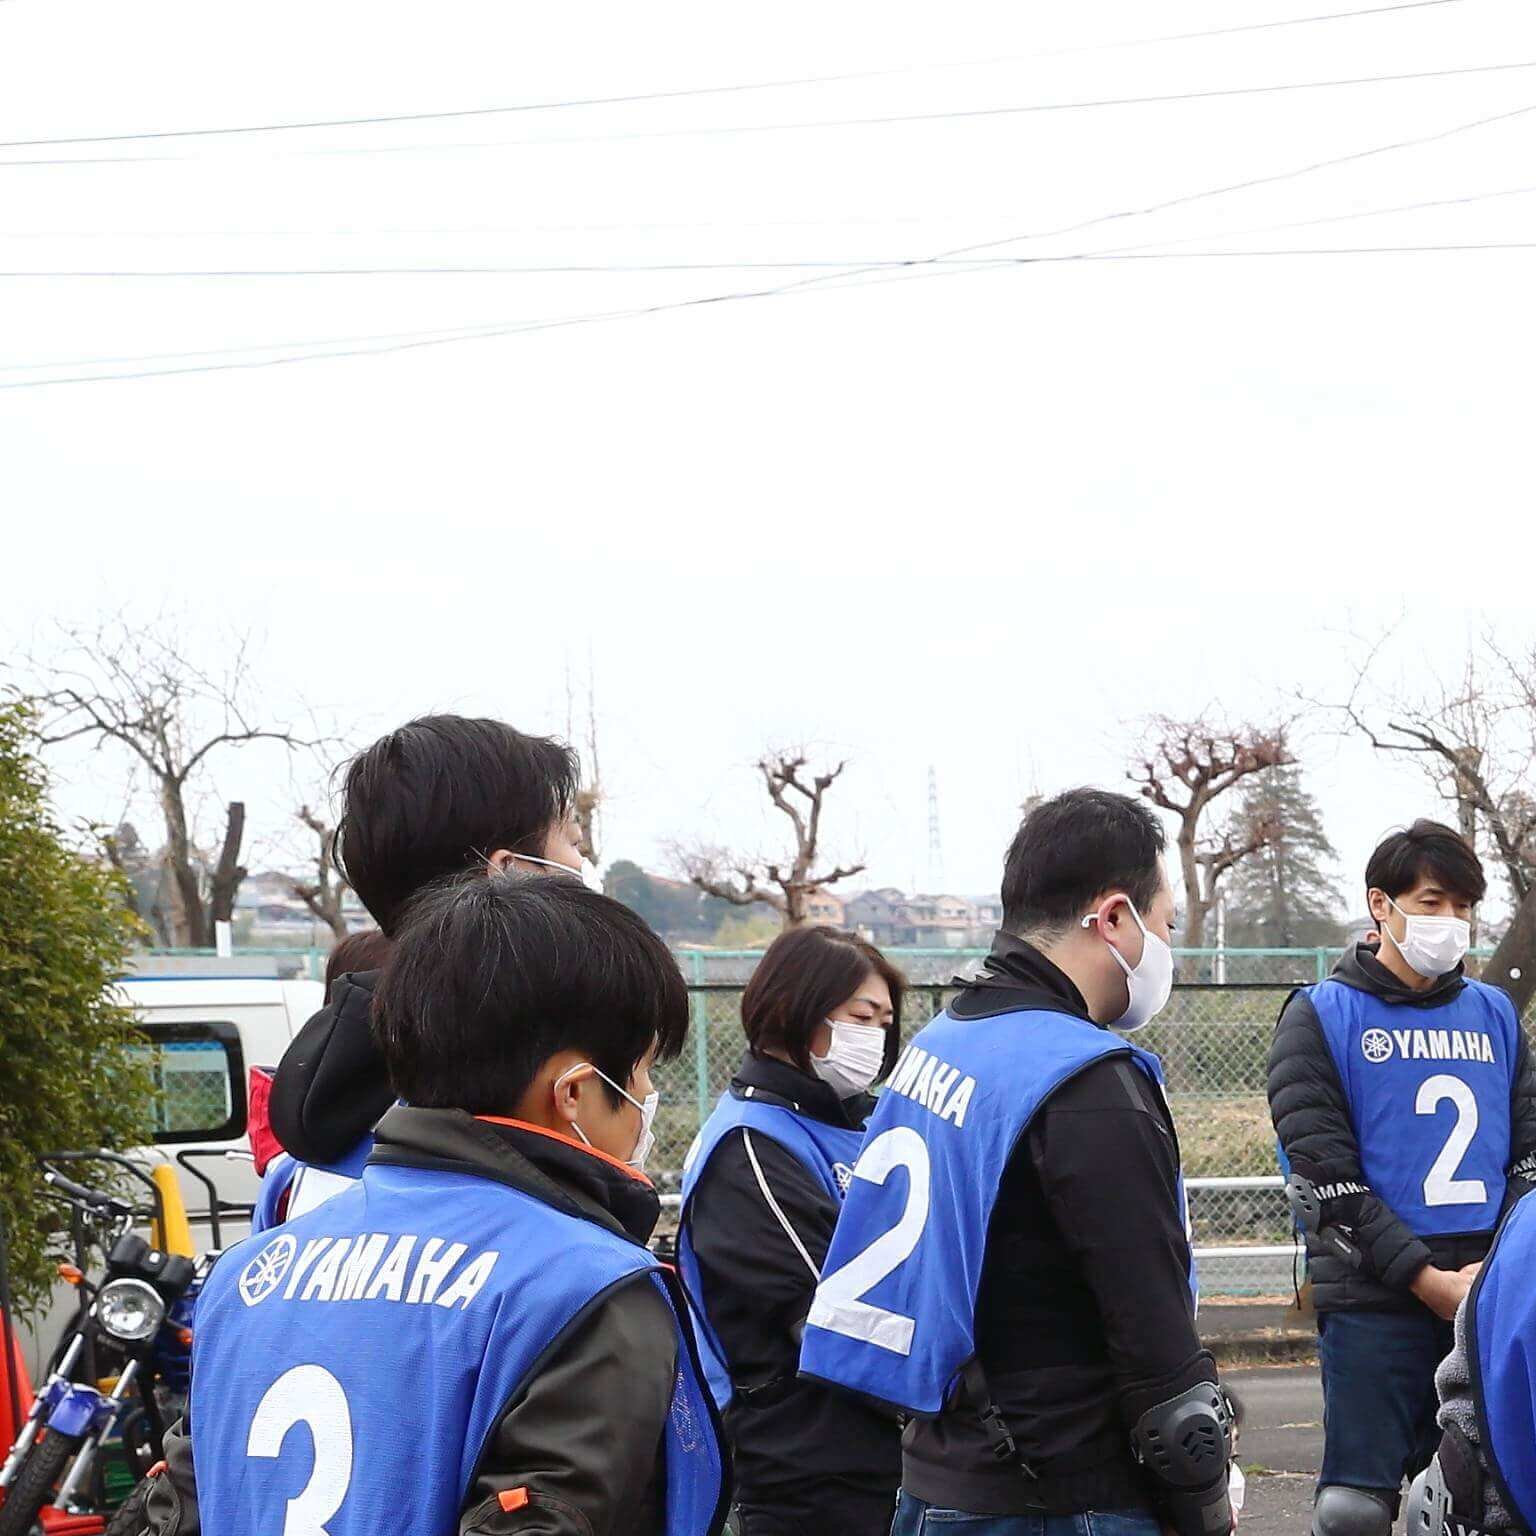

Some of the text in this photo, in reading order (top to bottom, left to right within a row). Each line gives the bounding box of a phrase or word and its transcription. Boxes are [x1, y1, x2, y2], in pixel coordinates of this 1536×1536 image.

[1395, 1030, 1494, 1064] YAMAHA
[1414, 1074, 1487, 1206] 2
[284, 1232, 499, 1311] YAMAHA
[806, 1126, 931, 1356] 2
